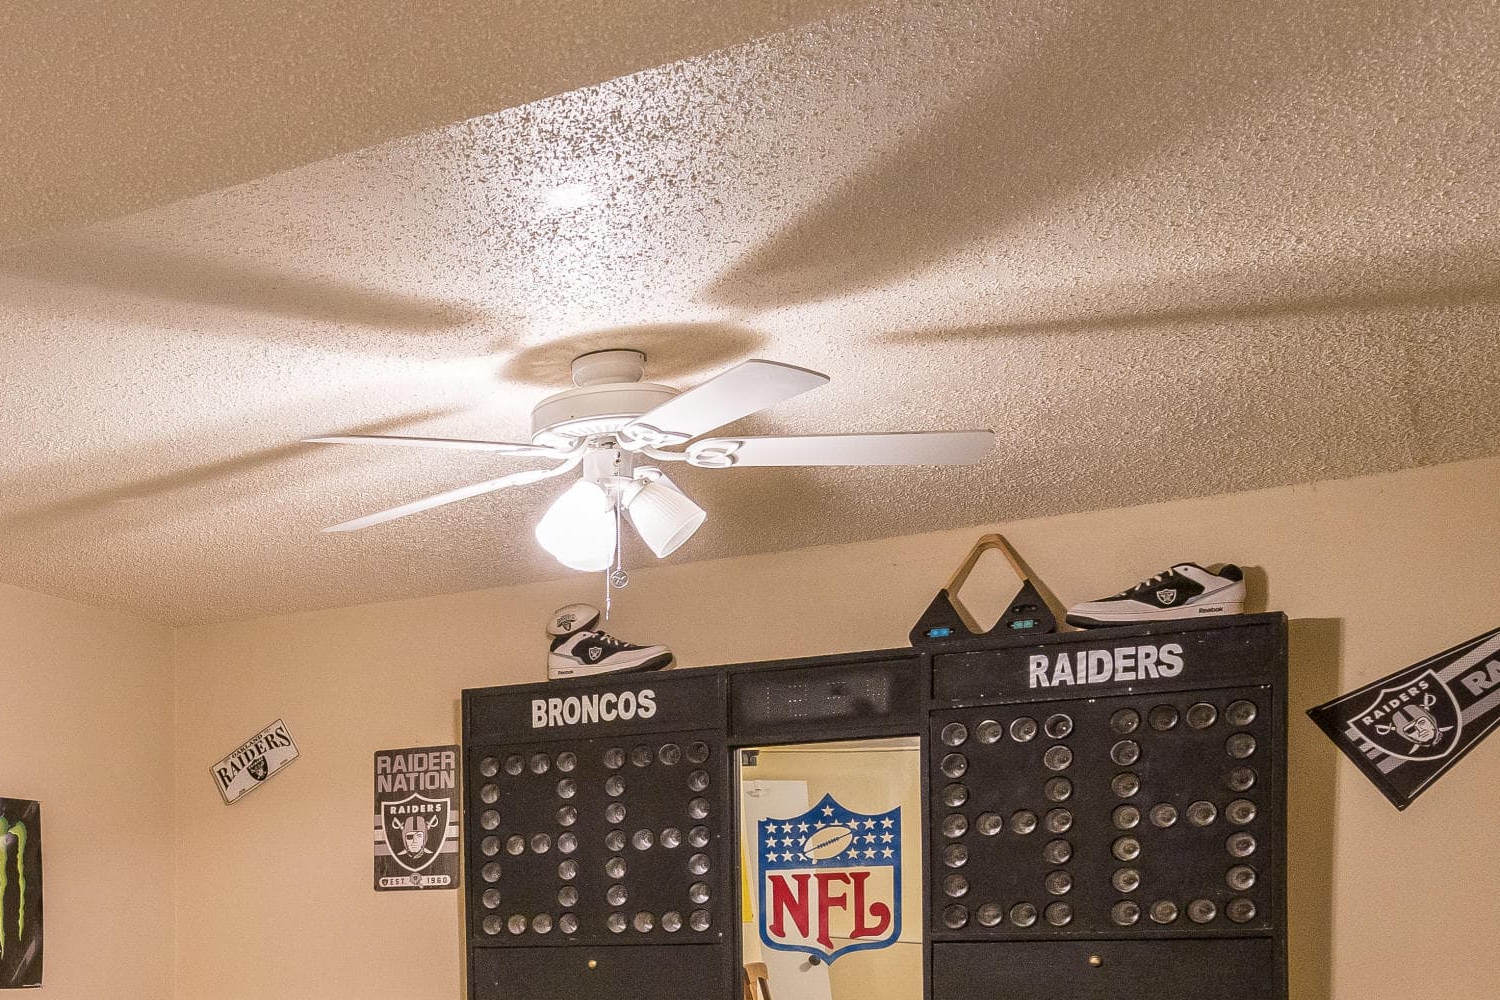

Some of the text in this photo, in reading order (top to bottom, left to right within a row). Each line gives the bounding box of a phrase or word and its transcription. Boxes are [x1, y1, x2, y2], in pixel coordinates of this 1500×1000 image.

[1029, 643, 1184, 689] RAIDERS
[531, 689, 657, 728] BRONCOS
[1361, 680, 1429, 726] RAIDERS
[216, 726, 291, 791] RAIDERS
[231, 734, 263, 759] OAKLAND
[377, 751, 456, 774] RAIDER
[377, 770, 455, 793] NATION
[390, 803, 442, 815] RAIDERS
[426, 876, 448, 884] 1960
[768, 871, 891, 950] NFL
